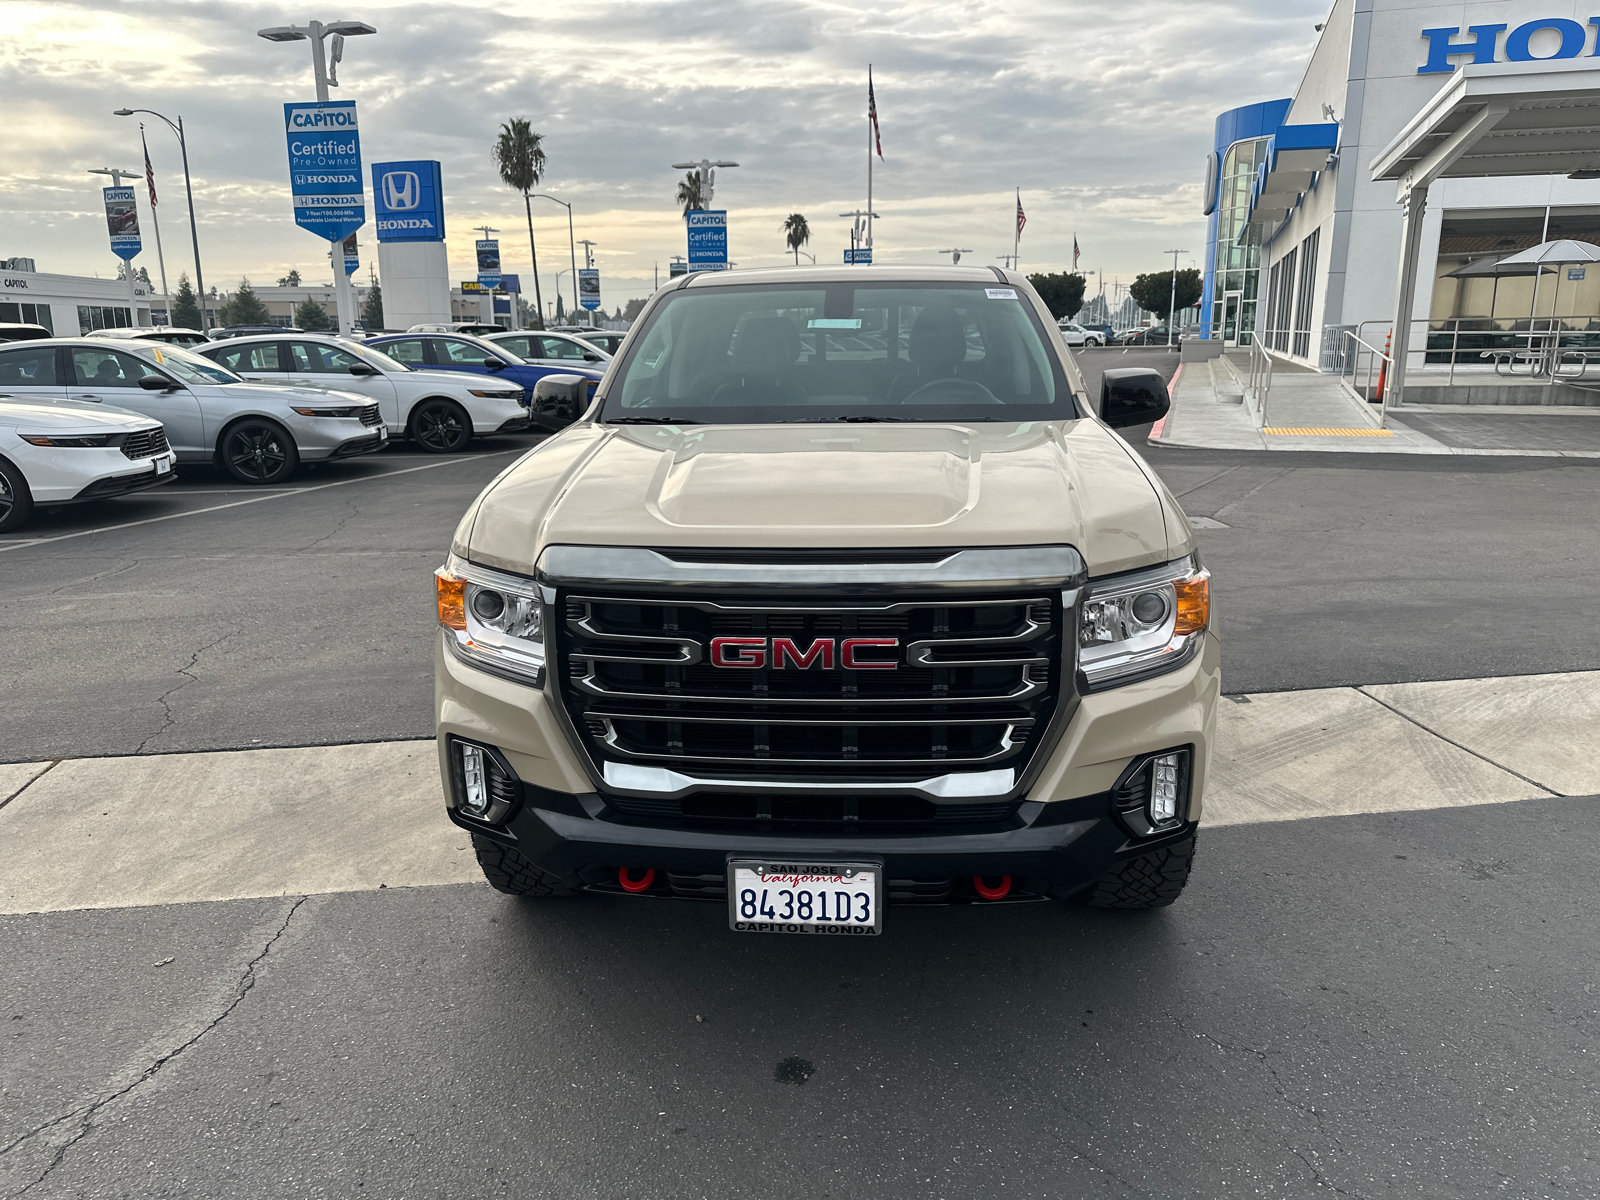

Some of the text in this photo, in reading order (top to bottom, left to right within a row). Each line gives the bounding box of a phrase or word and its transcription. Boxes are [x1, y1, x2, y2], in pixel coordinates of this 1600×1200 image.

[1417, 17, 1600, 74] HO
[293, 112, 355, 127] CAPITOL
[291, 139, 356, 156] Certified
[293, 155, 357, 166] Pre-Owned
[307, 175, 358, 183] HONDA
[106, 192, 135, 200] CAPITOL
[310, 197, 358, 205] HONDA
[378, 219, 434, 230] HONDA
[691, 216, 726, 225] CAPITOL
[689, 231, 725, 241] Certified
[4, 279, 28, 288] CAPITOL
[711, 637, 899, 670] GMC
[770, 865, 838, 875] SAN JOSE
[761, 873, 853, 887] California
[741, 889, 870, 922] 84381D3
[735, 922, 876, 935] CAPITOL HONDA
